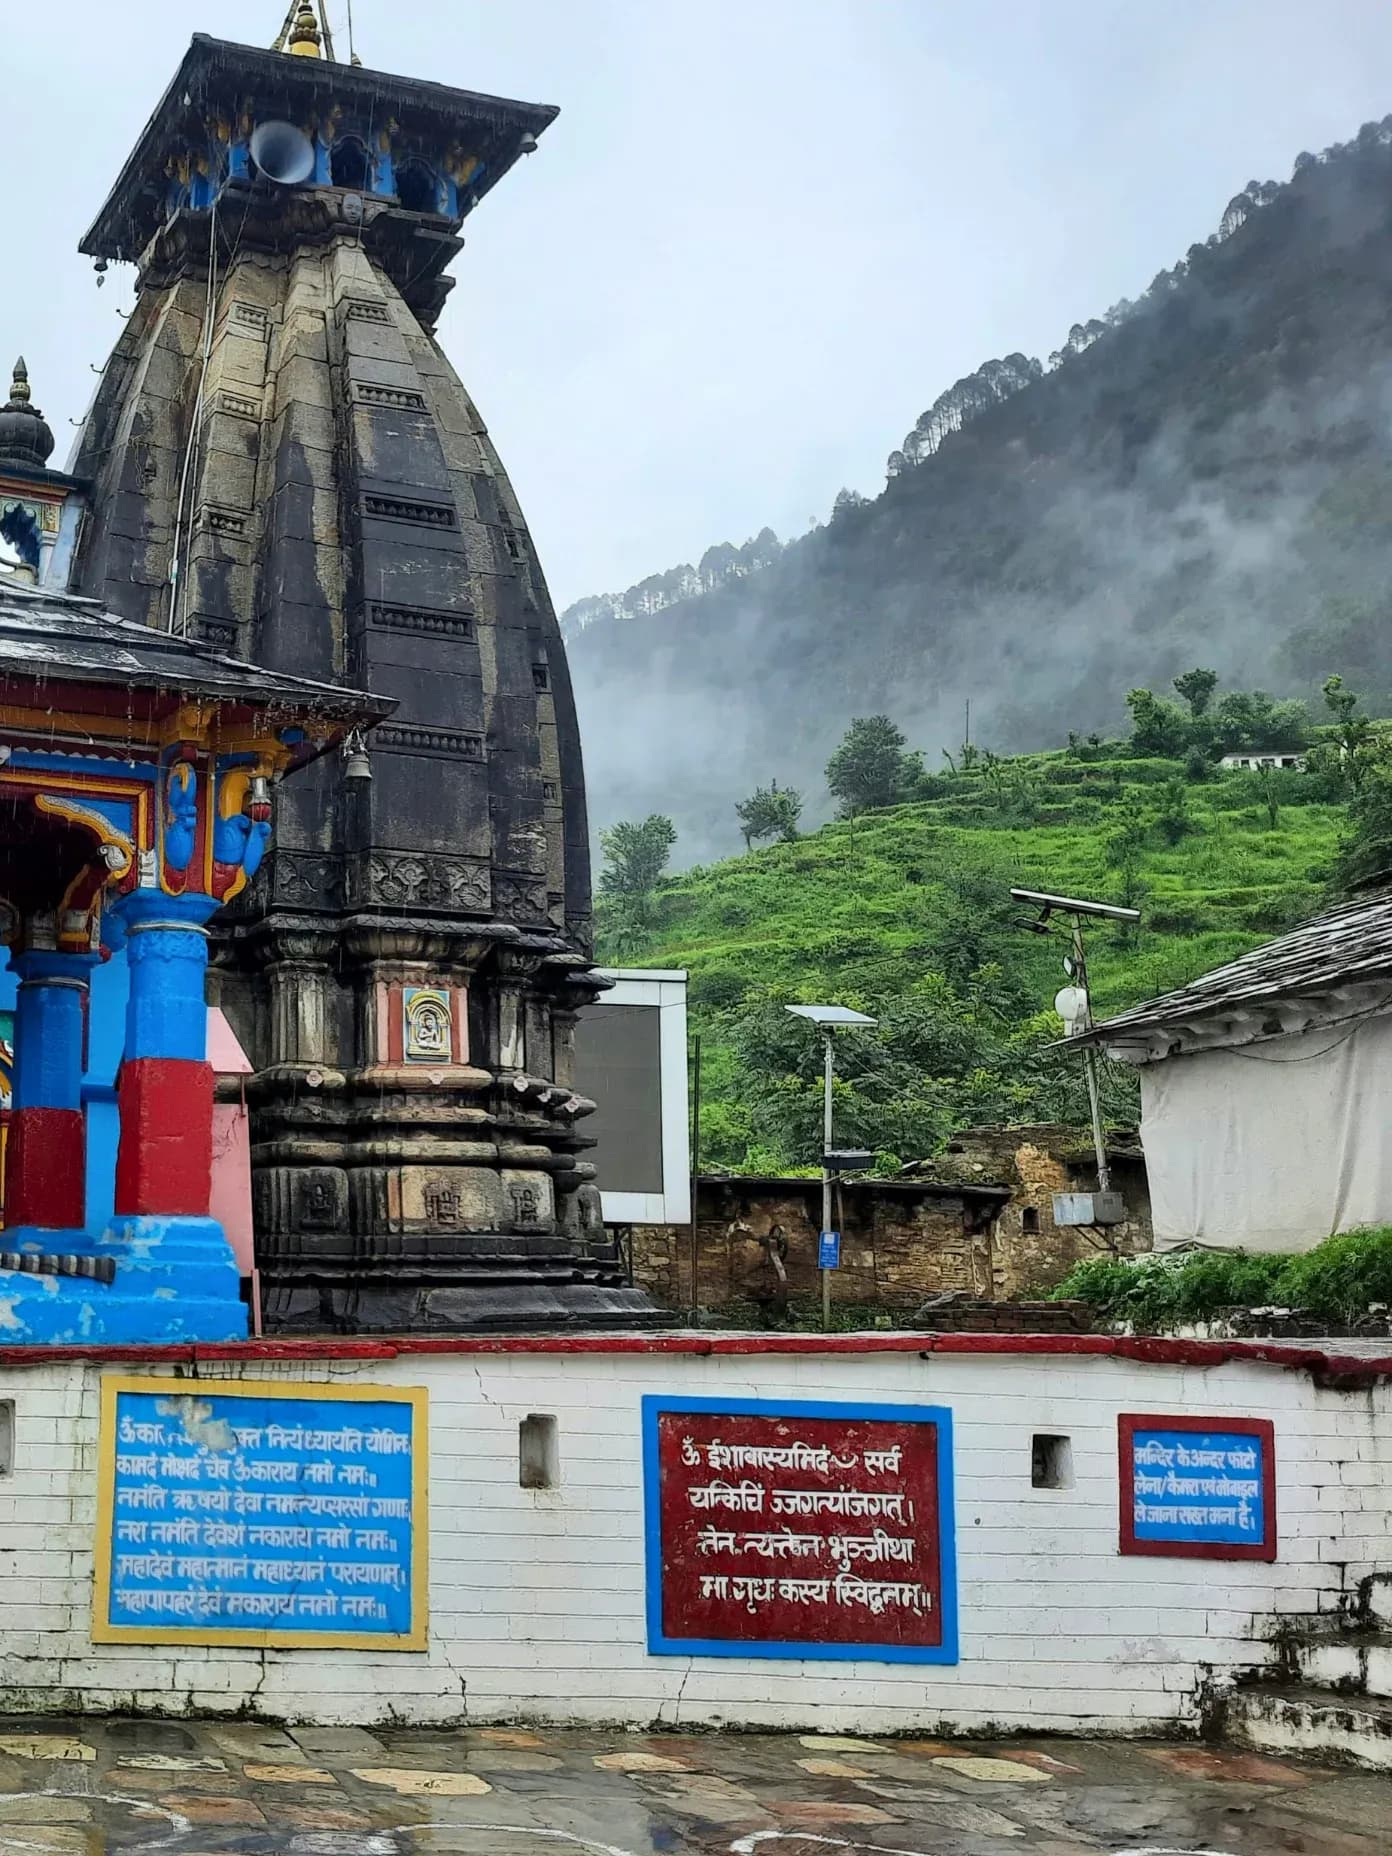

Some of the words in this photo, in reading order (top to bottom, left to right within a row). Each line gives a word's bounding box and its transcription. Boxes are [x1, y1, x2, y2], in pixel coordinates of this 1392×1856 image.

[204, 1454, 232, 1480] चैव
[303, 1458, 335, 1484] नमो
[1134, 1440, 1175, 1467] मन्दिर
[1176, 1441, 1190, 1467] के
[1190, 1450, 1226, 1470] अन्दर
[233, 1486, 264, 1515] देवा
[1134, 1497, 1146, 1523] ले
[1146, 1505, 1177, 1525] जाना
[1208, 1506, 1238, 1526] मना
[117, 1520, 148, 1543] नरा
[316, 1522, 352, 1549] नमो
[696, 1524, 737, 1556] तेन
[298, 1588, 339, 1617] नमो
[699, 1575, 729, 1601] मा
[778, 1578, 830, 1606] कस्य
